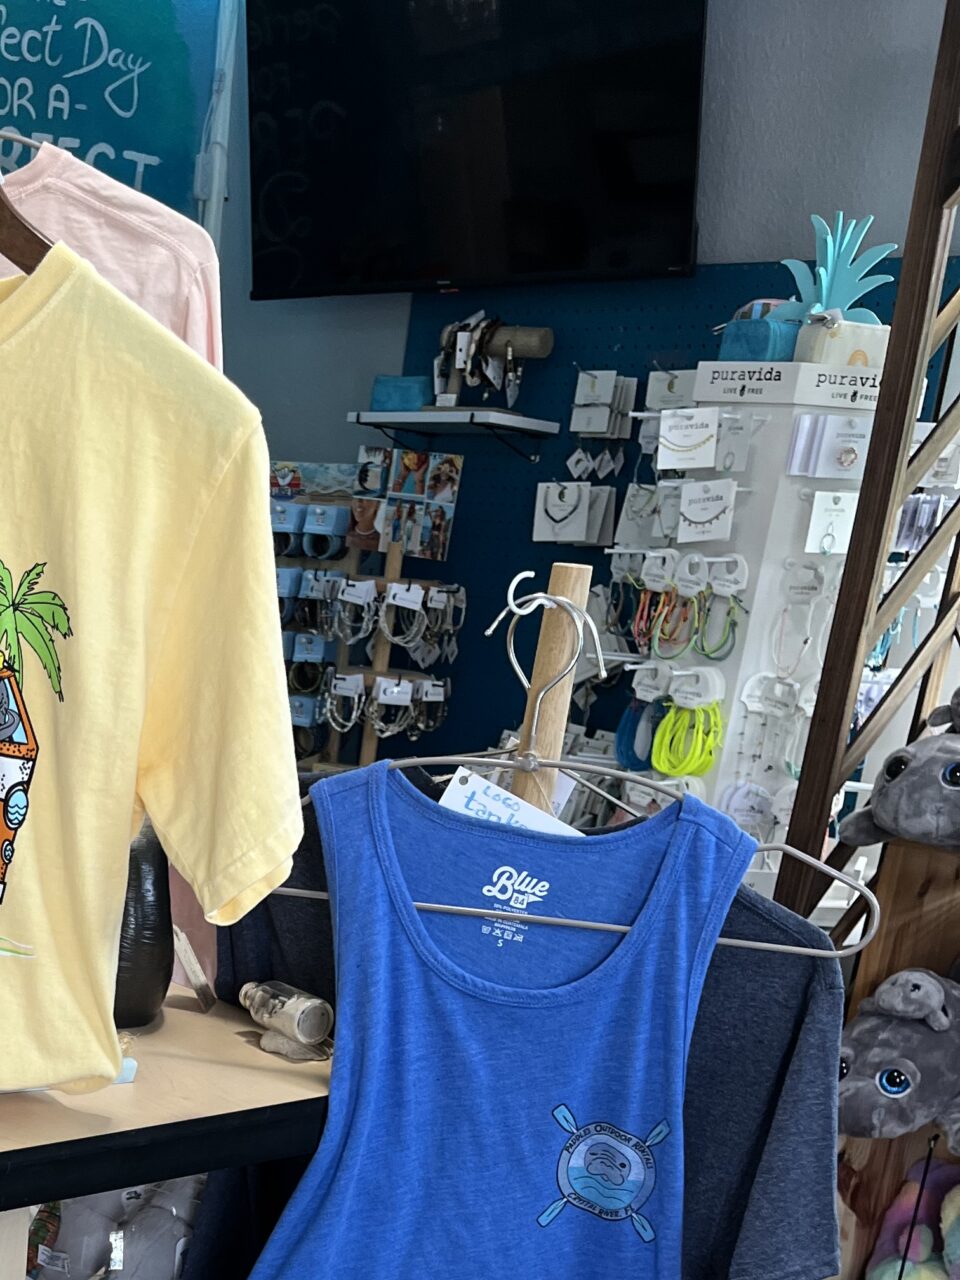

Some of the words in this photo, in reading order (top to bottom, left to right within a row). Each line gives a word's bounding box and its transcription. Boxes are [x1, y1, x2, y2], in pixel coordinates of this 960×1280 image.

[62, 17, 153, 118] Day
[710, 367, 782, 385] puravida
[816, 371, 880, 388] puravi
[722, 386, 738, 395] LIVE
[746, 387, 763, 396] FREE
[831, 392, 848, 400] LIVE
[481, 865, 550, 901] Blue
[496, 939, 504, 947] S
